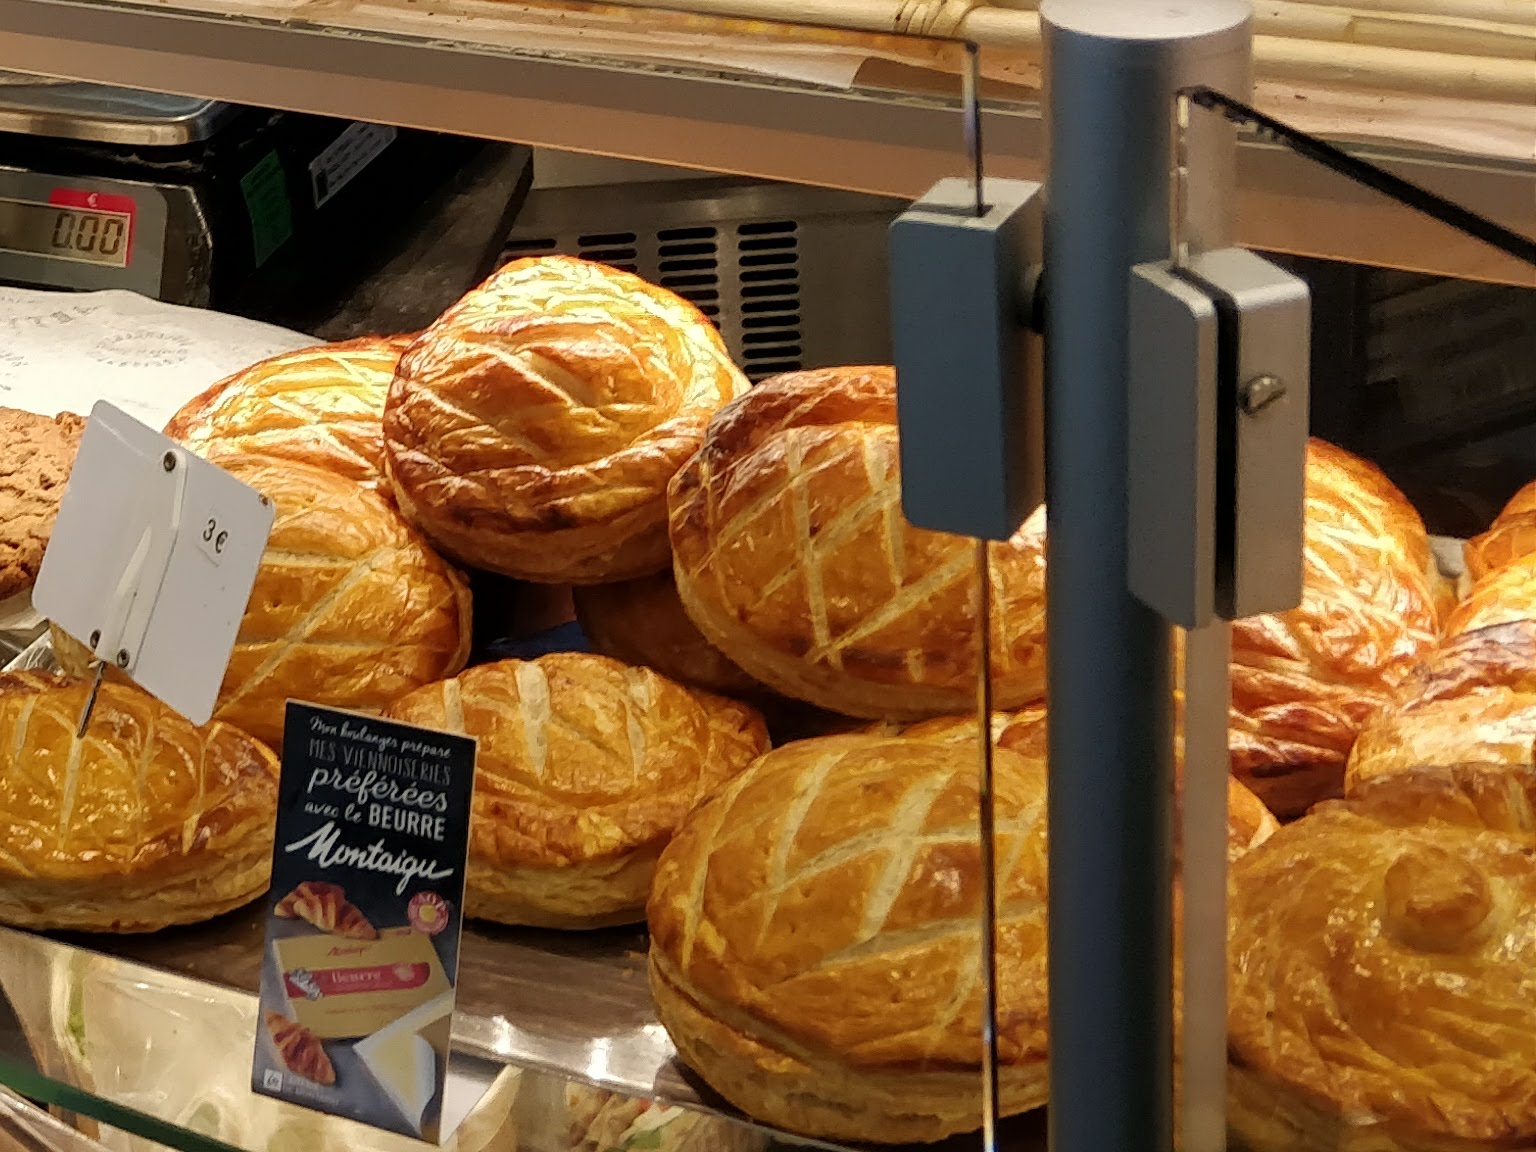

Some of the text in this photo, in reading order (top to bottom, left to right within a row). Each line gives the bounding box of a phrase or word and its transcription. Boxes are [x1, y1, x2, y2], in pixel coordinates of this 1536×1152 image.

[86, 192, 99, 209] €
[50, 210, 126, 257] 0.00
[339, 721, 398, 751] boulanger
[309, 737, 452, 787] MES VIENNOISERIES
[306, 767, 449, 813] préférées
[304, 800, 447, 842] avec le BEURRE
[285, 820, 455, 896] Montaigu
